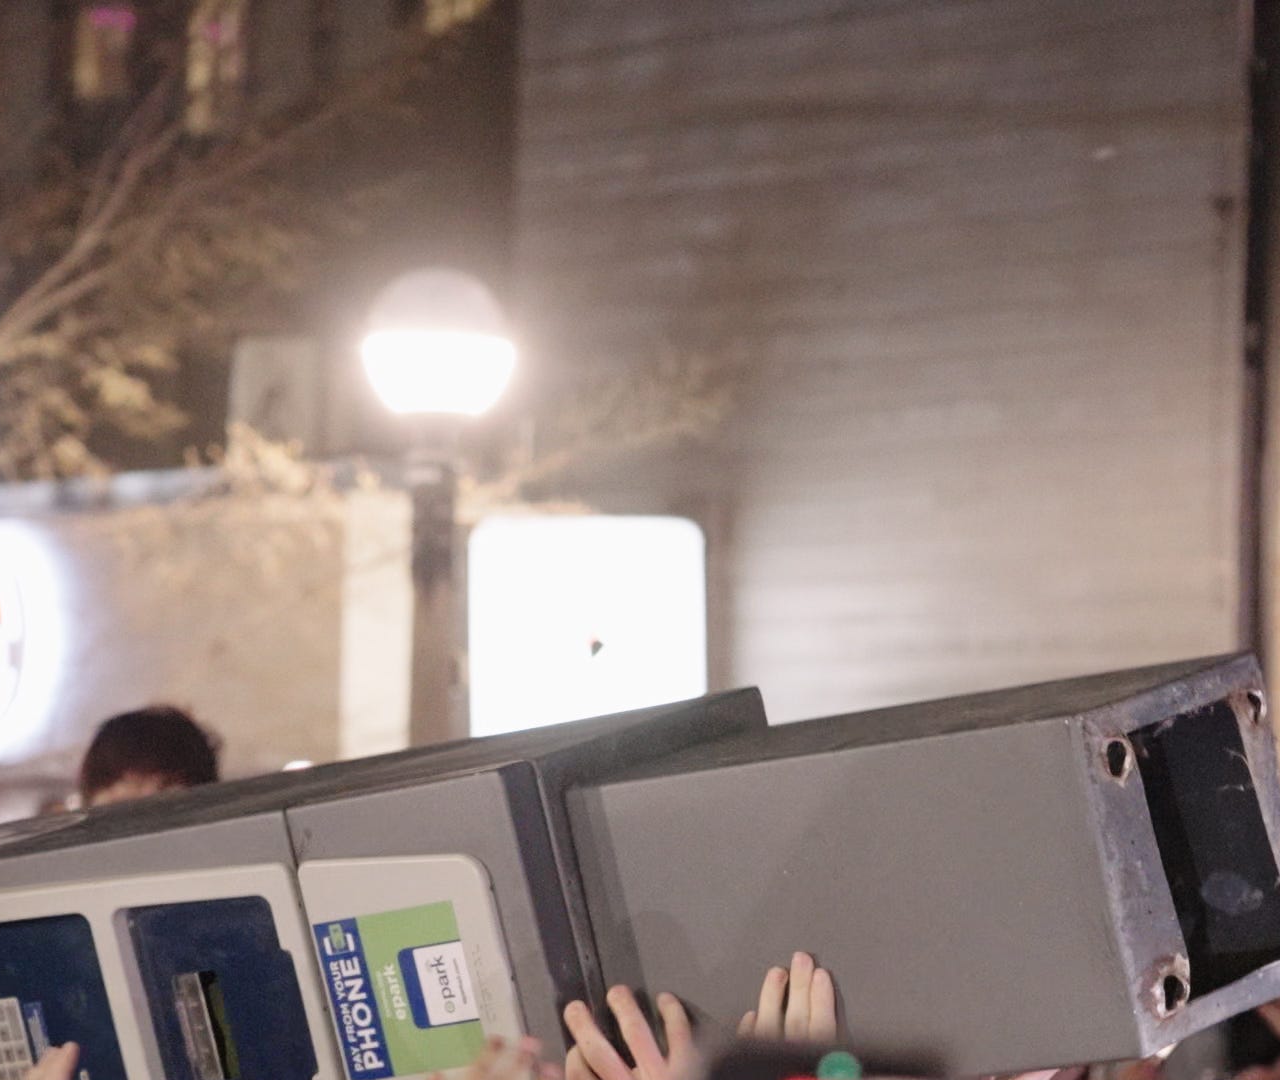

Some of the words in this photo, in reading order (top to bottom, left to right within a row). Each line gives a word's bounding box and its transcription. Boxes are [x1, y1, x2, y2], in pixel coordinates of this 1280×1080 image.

[329, 960, 346, 1000] YOUR
[383, 962, 407, 1020] epark
[339, 956, 385, 1071] PHONE
[339, 1003, 357, 1043] FROM
[349, 1046, 365, 1072] PAY
